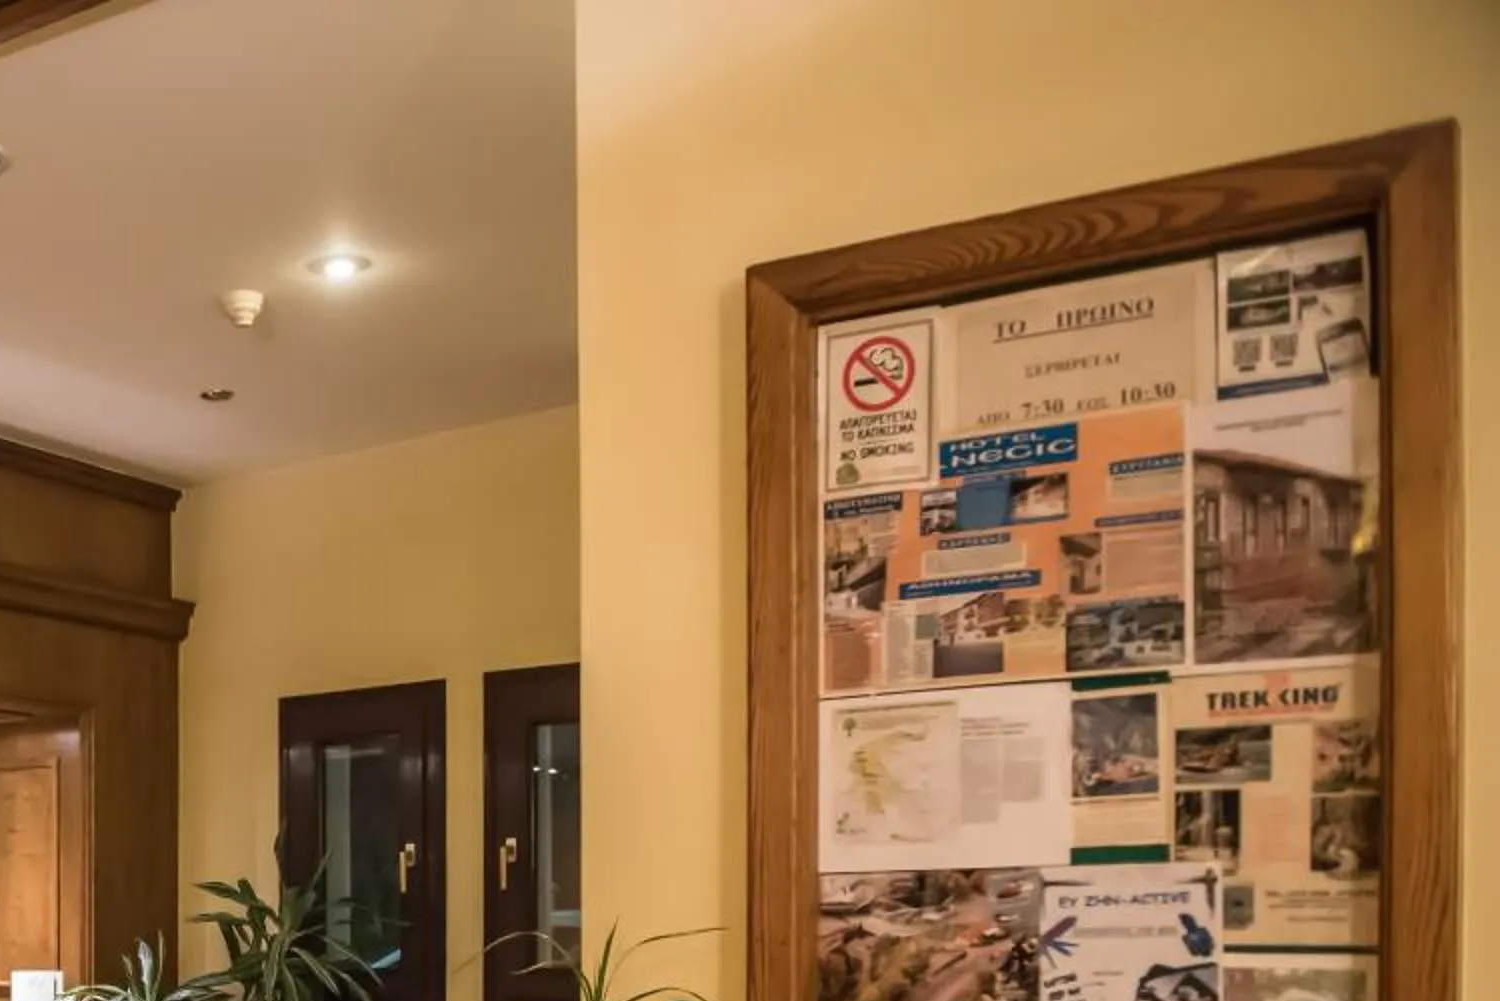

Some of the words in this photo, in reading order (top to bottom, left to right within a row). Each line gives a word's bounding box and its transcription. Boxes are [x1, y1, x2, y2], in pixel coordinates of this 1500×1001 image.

[1020, 398, 1064, 421] 7:30
[1121, 382, 1176, 406] 10:30
[860, 442, 914, 460] SMOKING
